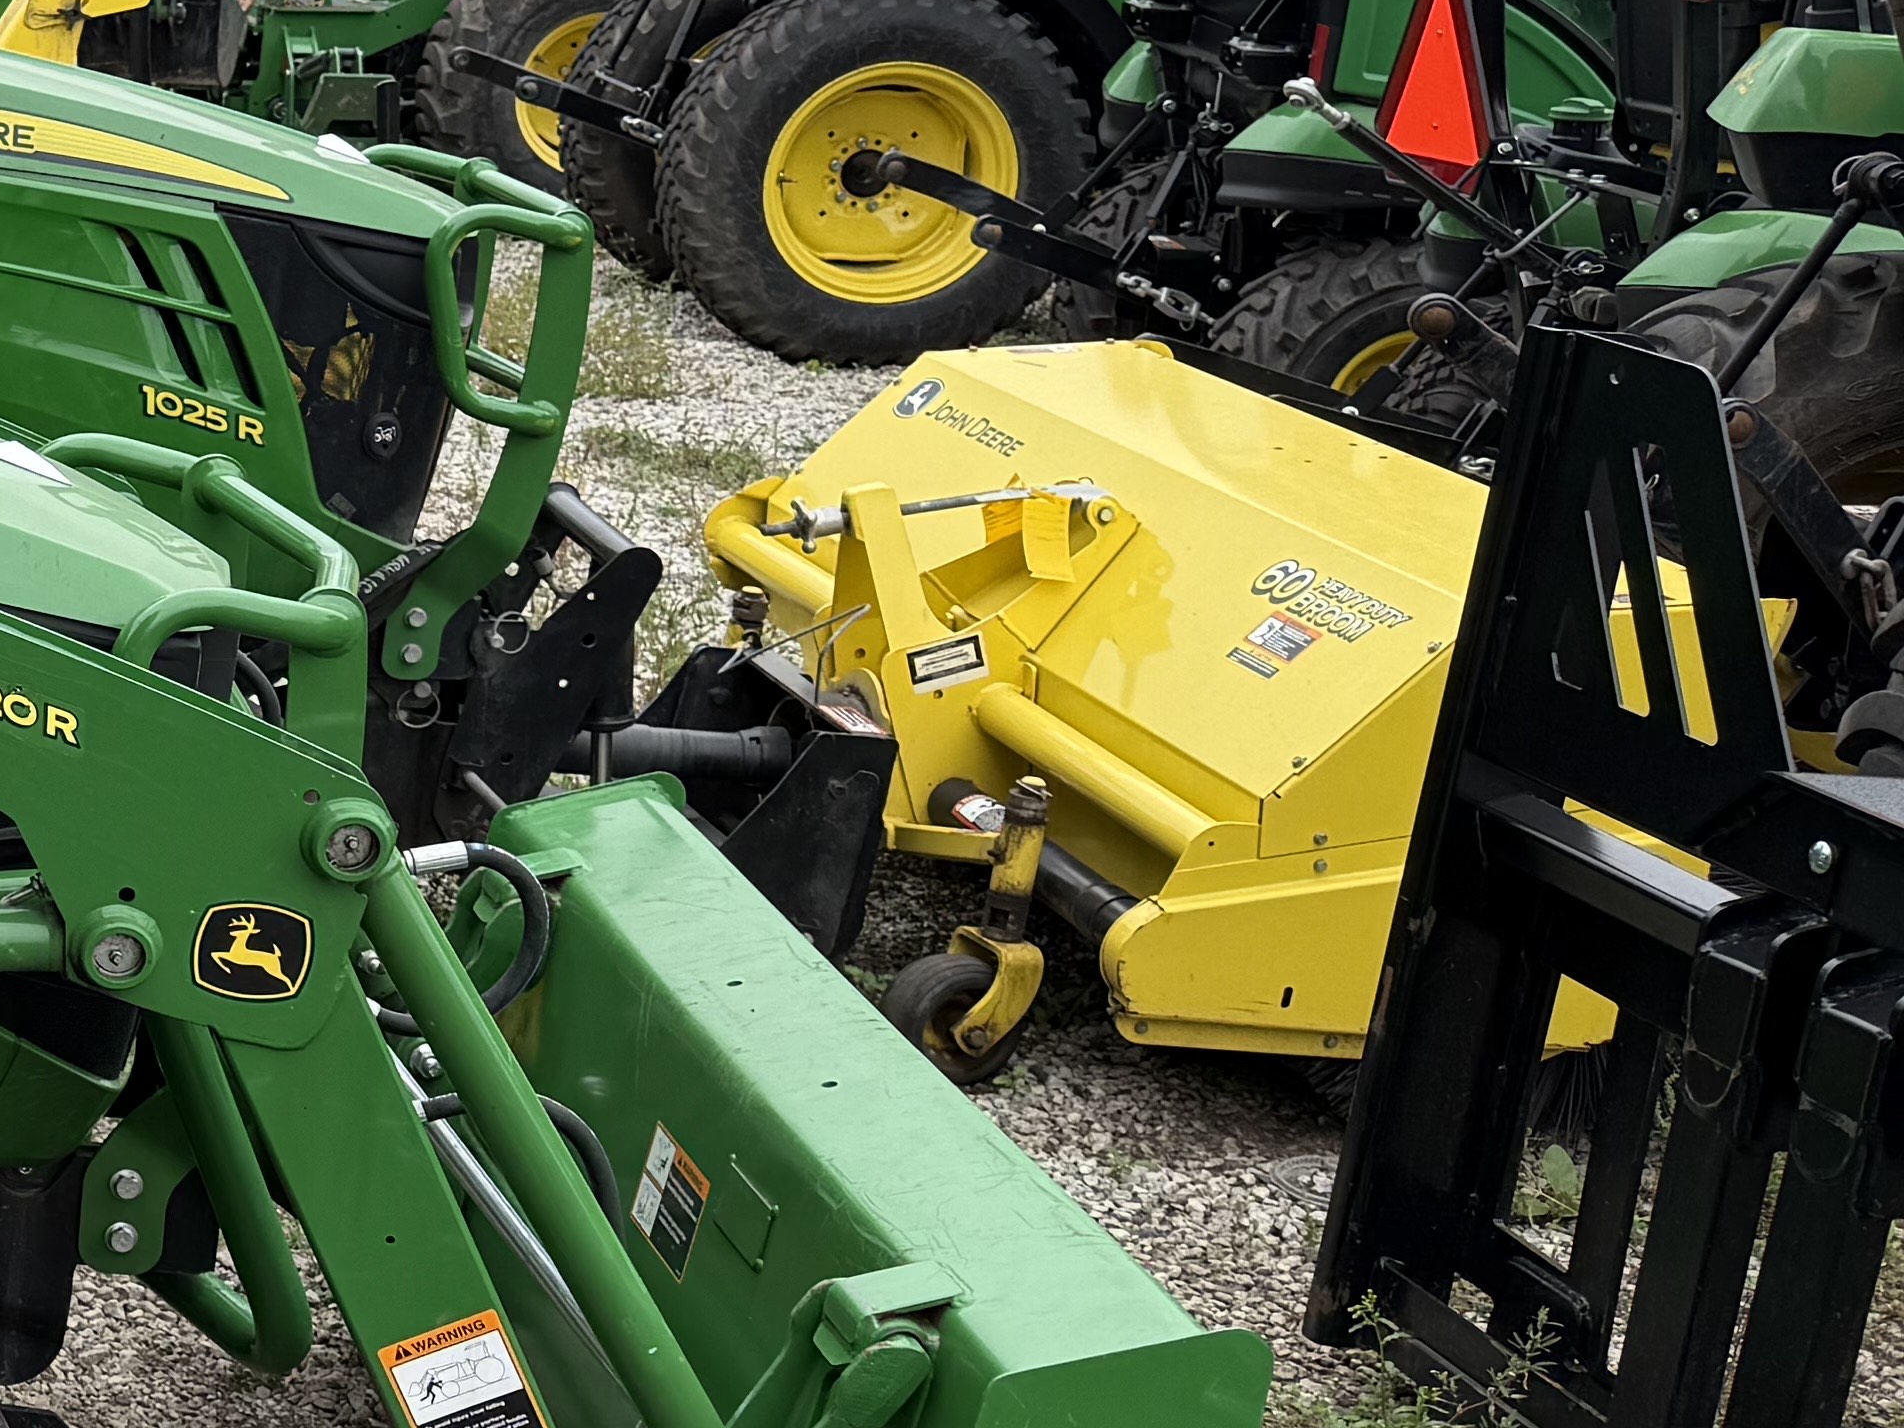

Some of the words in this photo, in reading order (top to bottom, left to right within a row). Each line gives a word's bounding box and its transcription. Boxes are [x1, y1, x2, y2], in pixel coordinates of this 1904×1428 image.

[140, 383, 229, 433] 1025
[237, 414, 265, 447] R
[925, 399, 973, 433] JOHN
[964, 417, 1025, 458] DEERE
[1250, 559, 1318, 605] 60
[1313, 577, 1369, 609] HEAVY
[1358, 599, 1413, 628] DUTY
[1285, 592, 1375, 643] BROOM
[45, 704, 80, 747] R
[410, 1319, 486, 1354] WARNING
